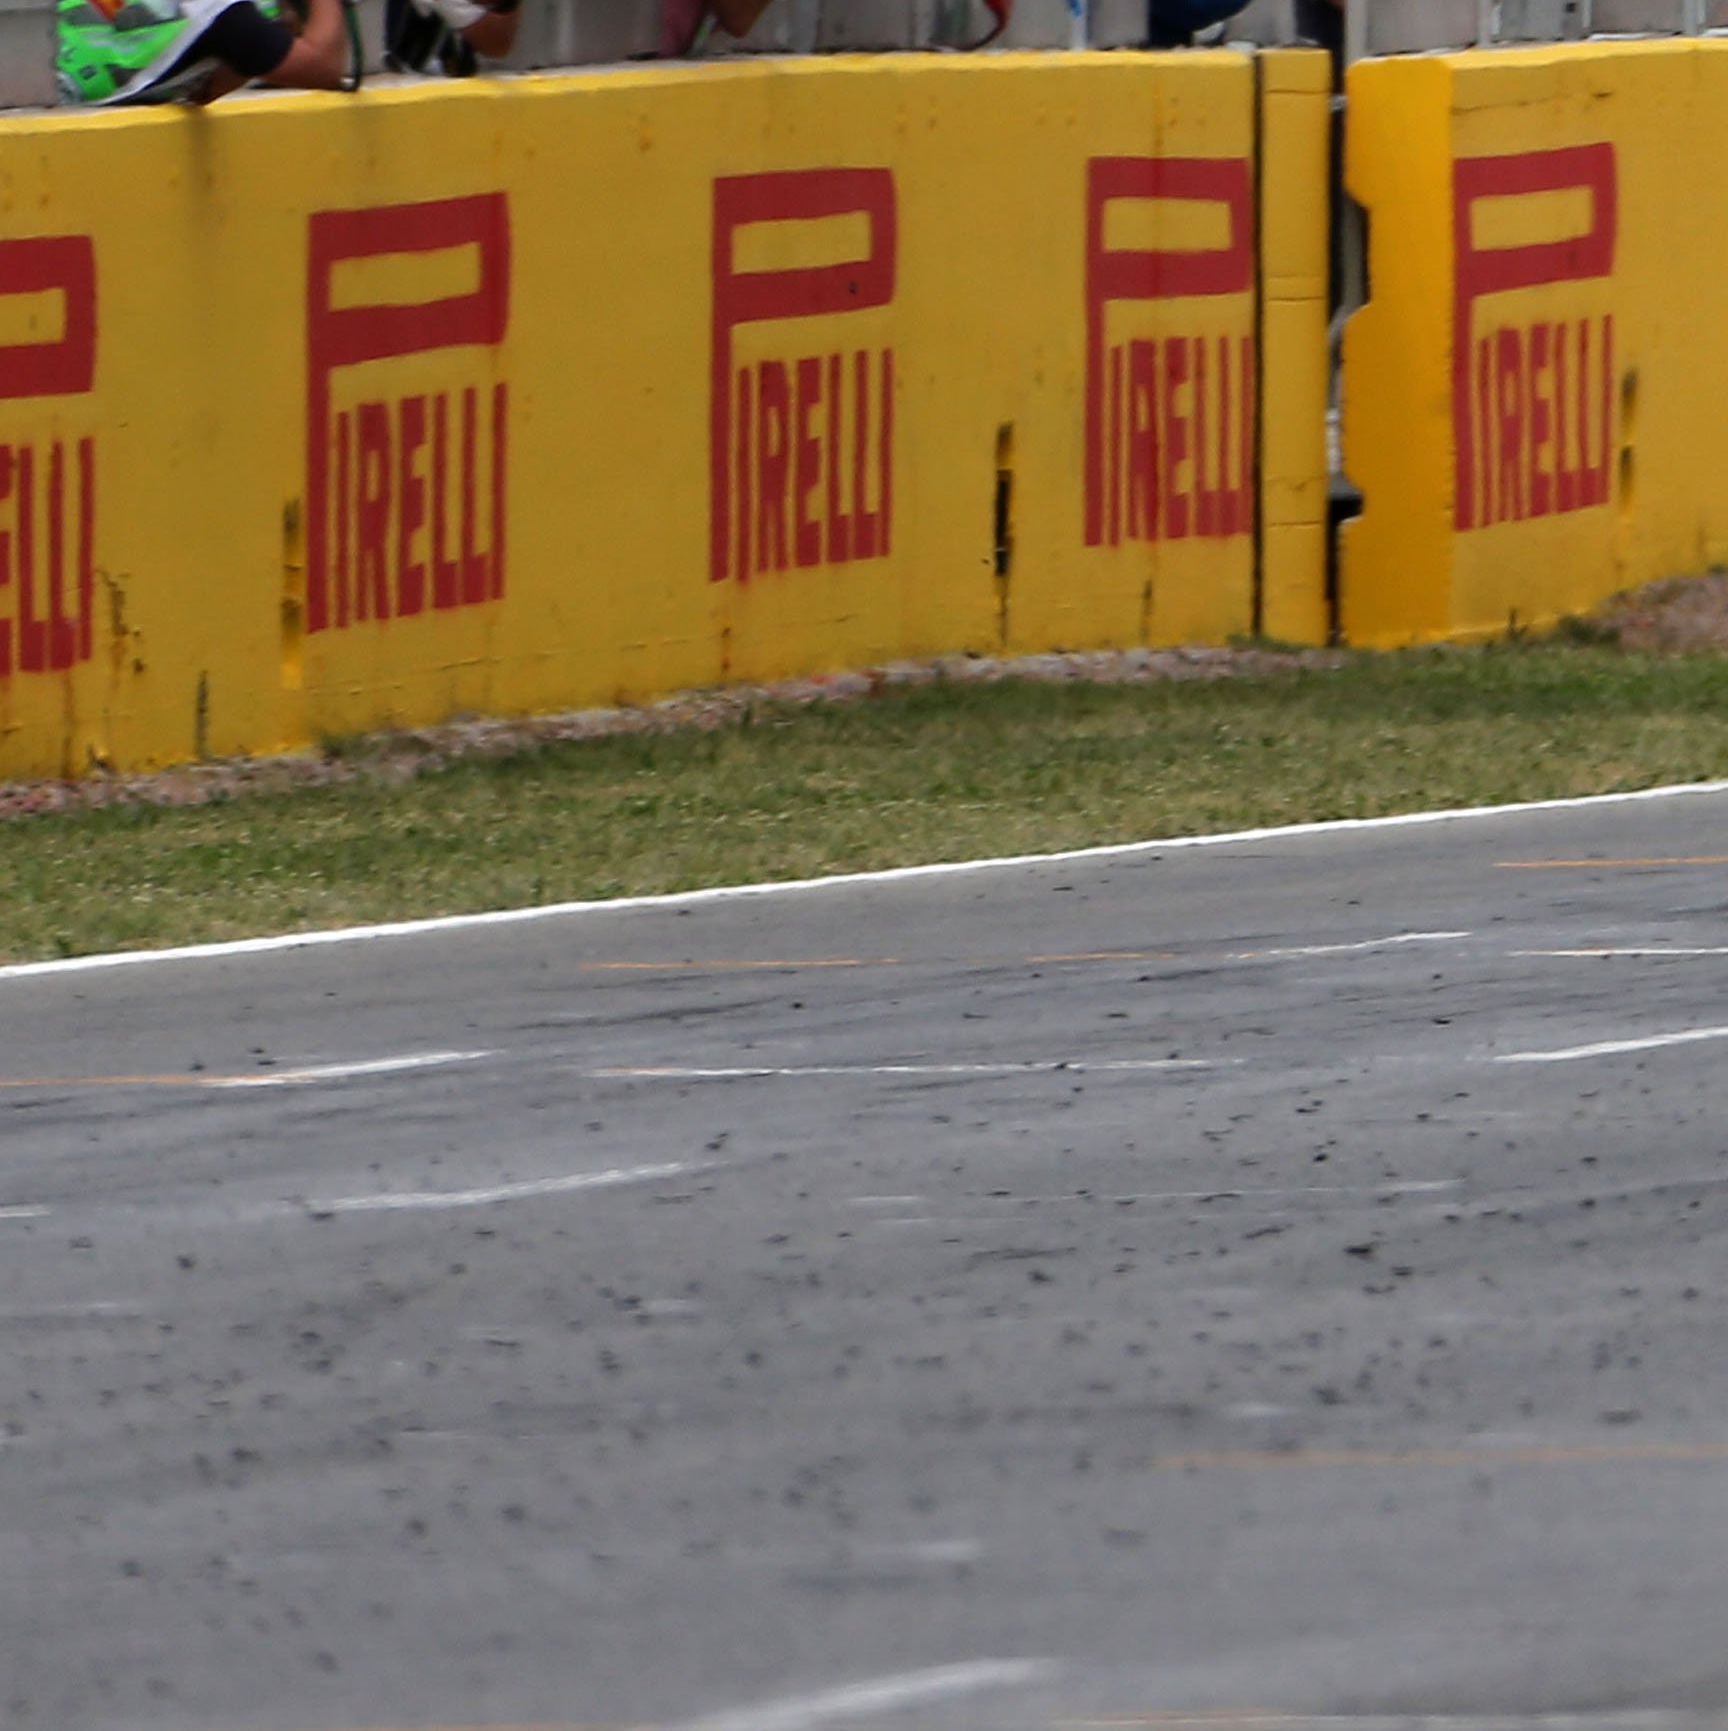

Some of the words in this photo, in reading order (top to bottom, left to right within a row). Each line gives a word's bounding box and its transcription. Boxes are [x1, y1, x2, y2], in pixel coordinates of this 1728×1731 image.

[307, 191, 512, 636] PIRELLI
[710, 167, 897, 586] PIRELLI
[1083, 156, 1252, 548] PIRELLI
[1452, 141, 1617, 534] PIRELLI
